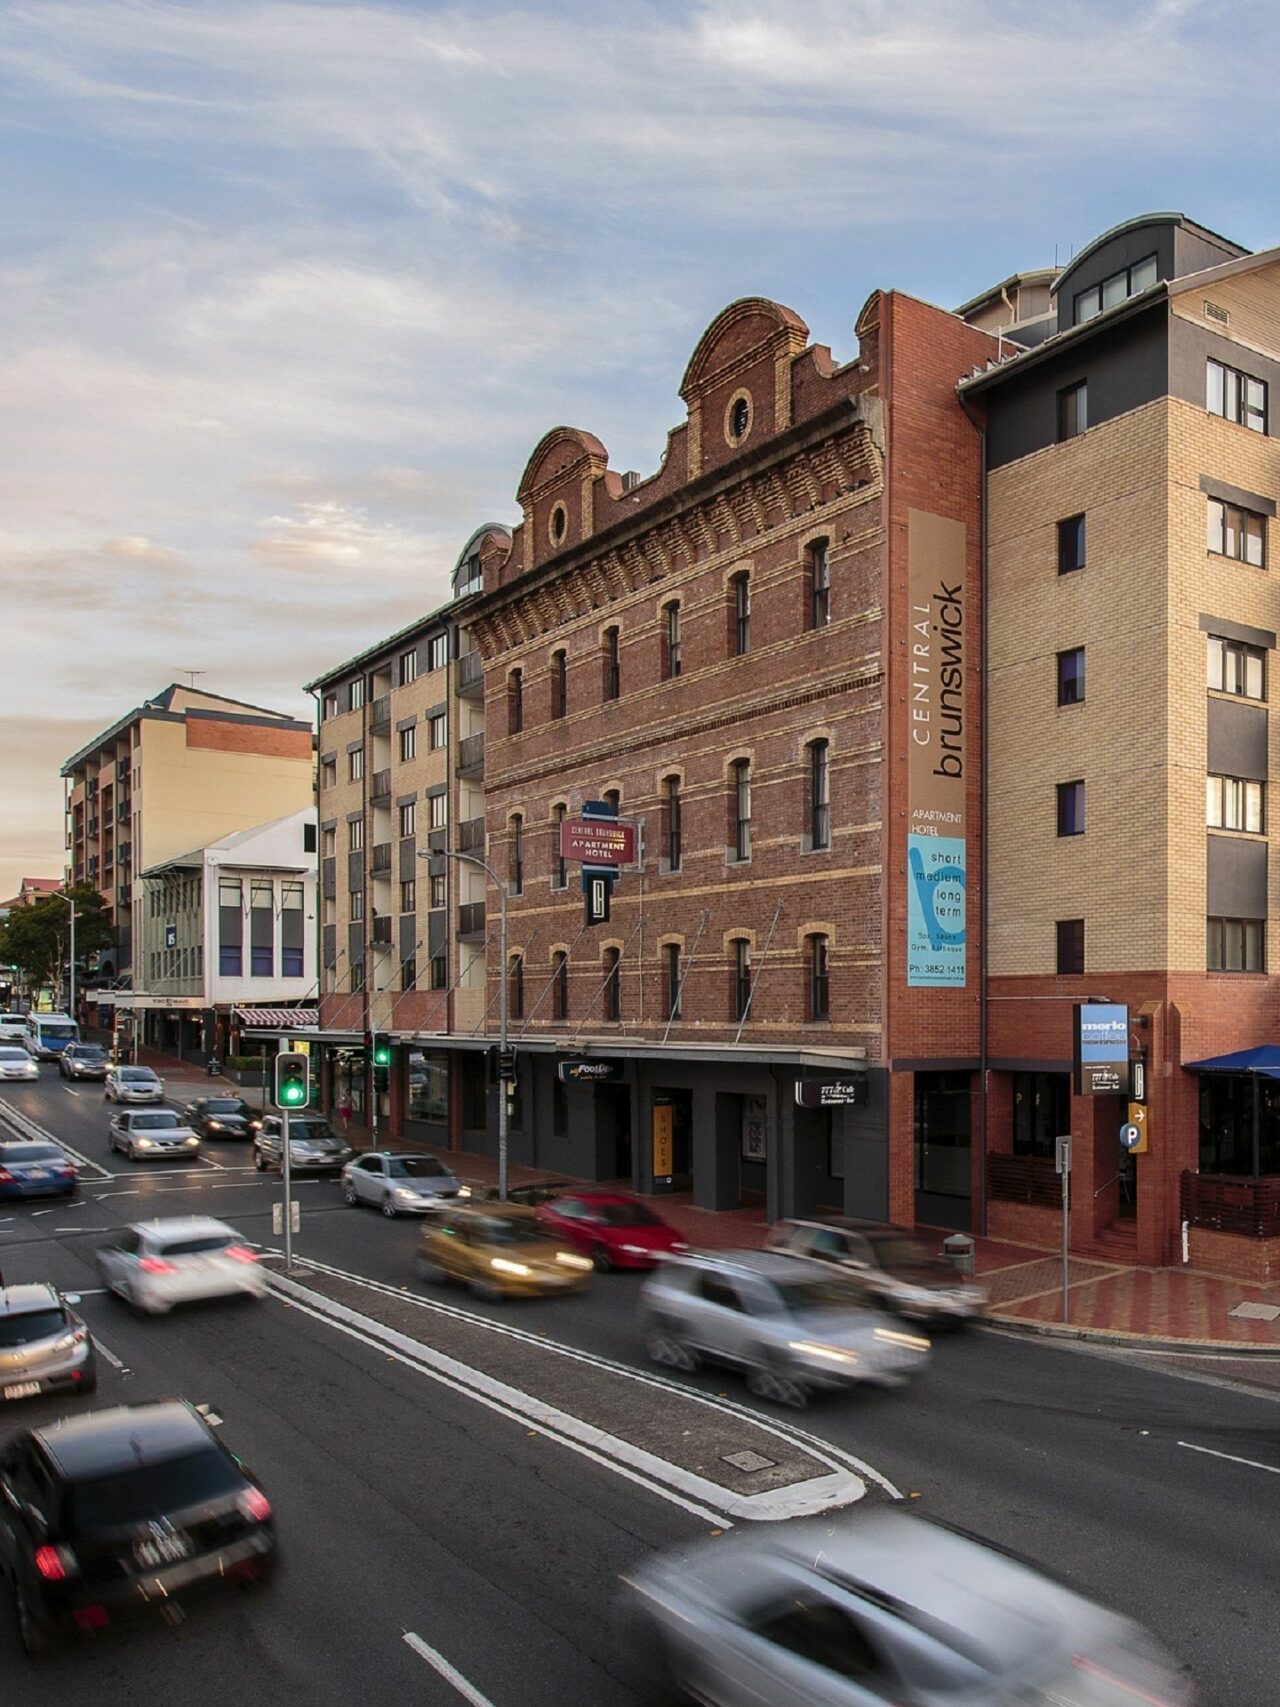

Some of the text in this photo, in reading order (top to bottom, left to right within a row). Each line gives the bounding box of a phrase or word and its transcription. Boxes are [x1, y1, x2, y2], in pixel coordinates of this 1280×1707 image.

[913, 603, 930, 746] CENTRAL
[933, 580, 963, 778] brunswick
[912, 809, 962, 823] APARTMENT
[911, 824, 939, 836] HOTEL
[572, 840, 625, 851] APARTMENT
[585, 849, 612, 858] HOTEL
[931, 852, 961, 864] short
[916, 872, 961, 883] medium
[936, 889, 961, 903] long
[935, 905, 961, 917] term
[925, 964, 945, 974] 3852
[947, 965, 965, 974] 1411
[1082, 1021, 1127, 1030] merlo
[1128, 1126, 1138, 1145] P
